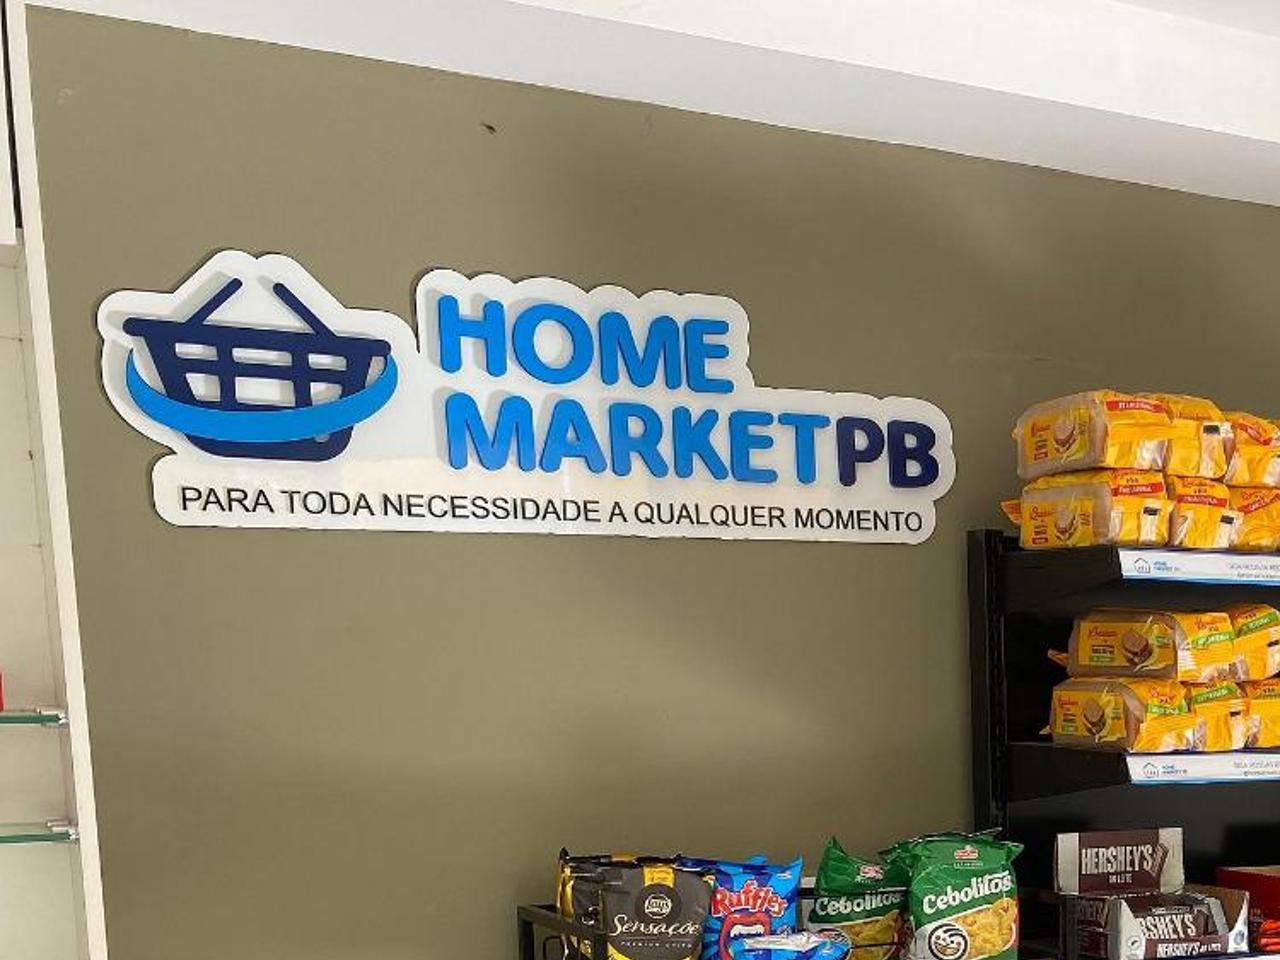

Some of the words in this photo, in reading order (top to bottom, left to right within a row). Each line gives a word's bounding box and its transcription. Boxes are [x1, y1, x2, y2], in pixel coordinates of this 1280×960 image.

[437, 294, 735, 394] HOME
[181, 486, 274, 513] PARA
[281, 489, 375, 516] TODA
[383, 493, 600, 522] NECESSIDADE
[608, 501, 628, 523] A
[634, 501, 785, 528] QUALQUER
[794, 507, 923, 532] MOMENTO
[1081, 844, 1153, 875] HERSHEY'S
[711, 880, 788, 917] Ruffles
[923, 870, 1013, 914] Cebolitos
[608, 914, 701, 937] Sensaçõe
